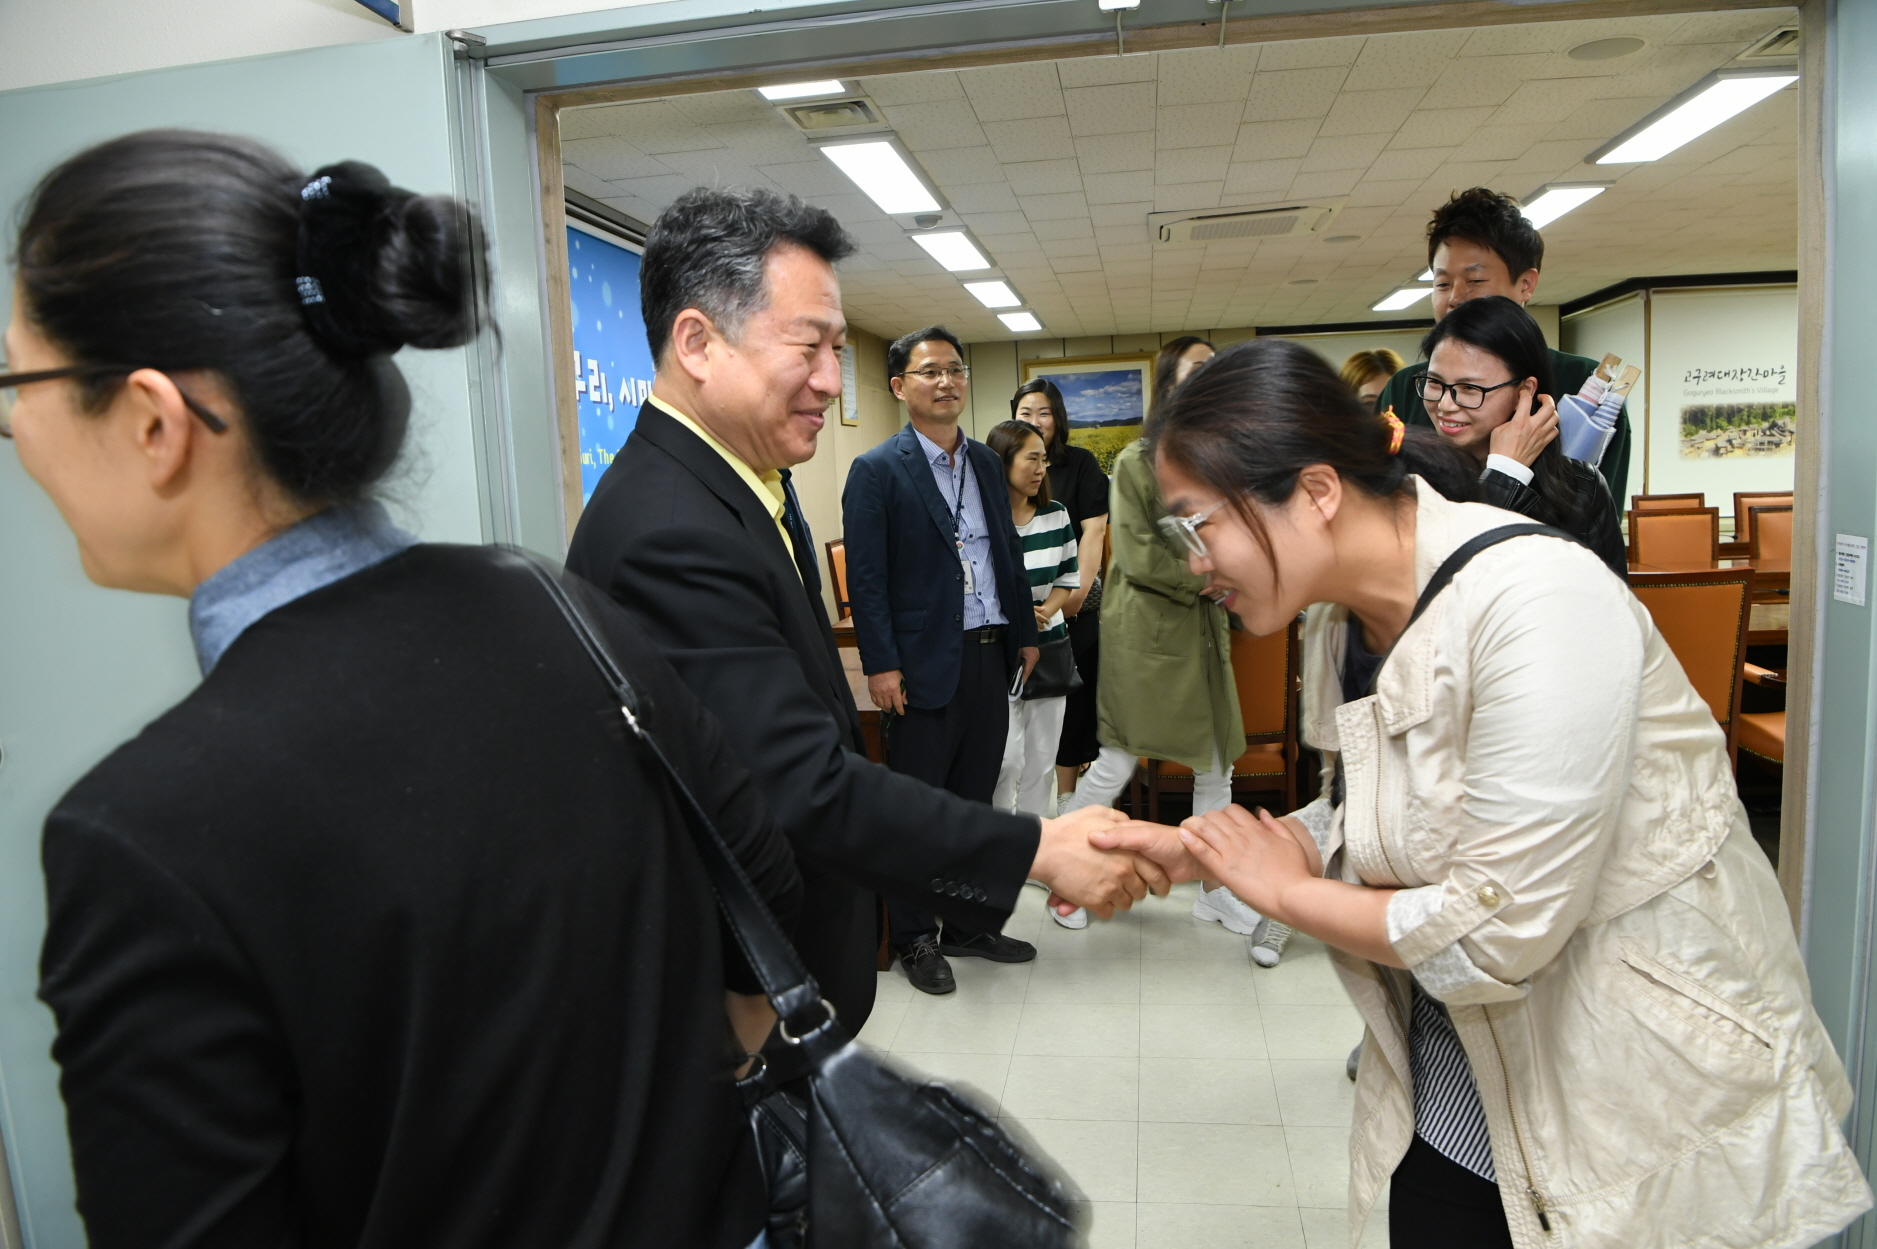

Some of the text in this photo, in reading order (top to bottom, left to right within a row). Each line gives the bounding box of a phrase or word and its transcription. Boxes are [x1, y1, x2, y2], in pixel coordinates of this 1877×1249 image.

[1684, 364, 1787, 386] 고구려대장간마을
[1683, 386, 1779, 398] Goguryeo Blacksmith's Village
[580, 448, 615, 469] uri, The
